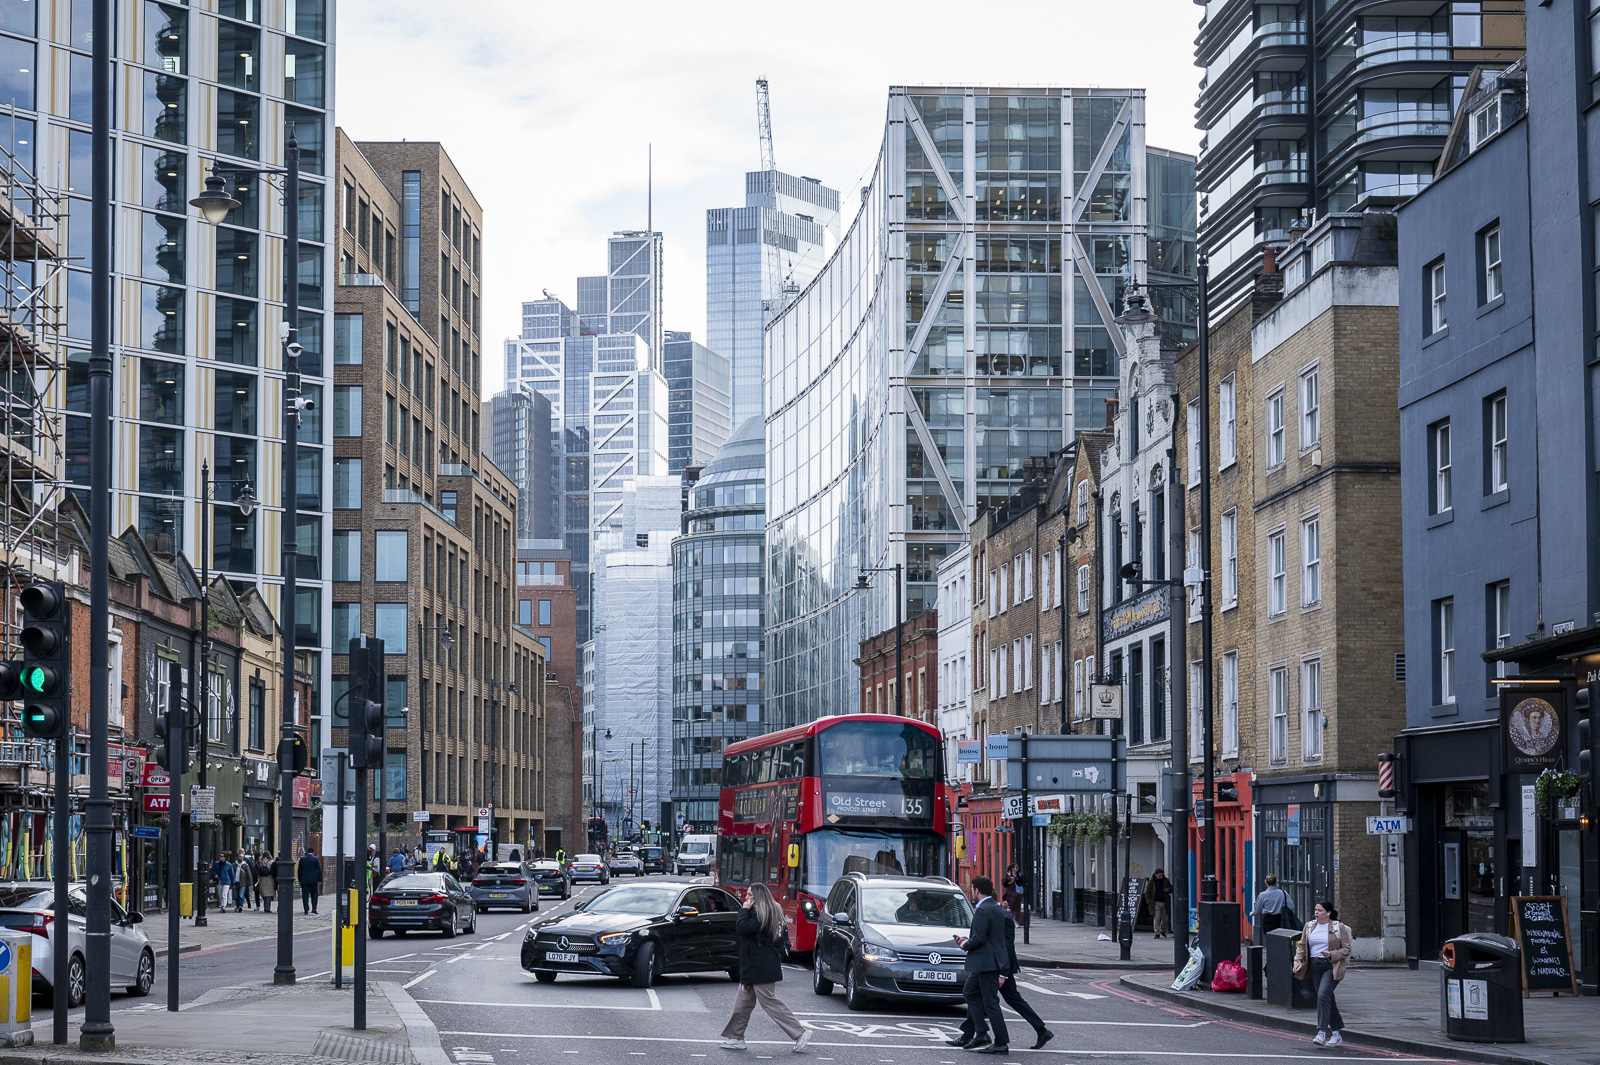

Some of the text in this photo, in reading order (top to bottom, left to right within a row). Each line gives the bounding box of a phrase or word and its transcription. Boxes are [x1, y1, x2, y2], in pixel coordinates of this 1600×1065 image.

[832, 796, 886, 808] Old Street
[901, 798, 922, 815] 135
[1008, 805, 1035, 816] LICECE
[1376, 820, 1400, 830] ATM
[1531, 966, 1536, 975] 6
[937, 972, 952, 980] CUG
